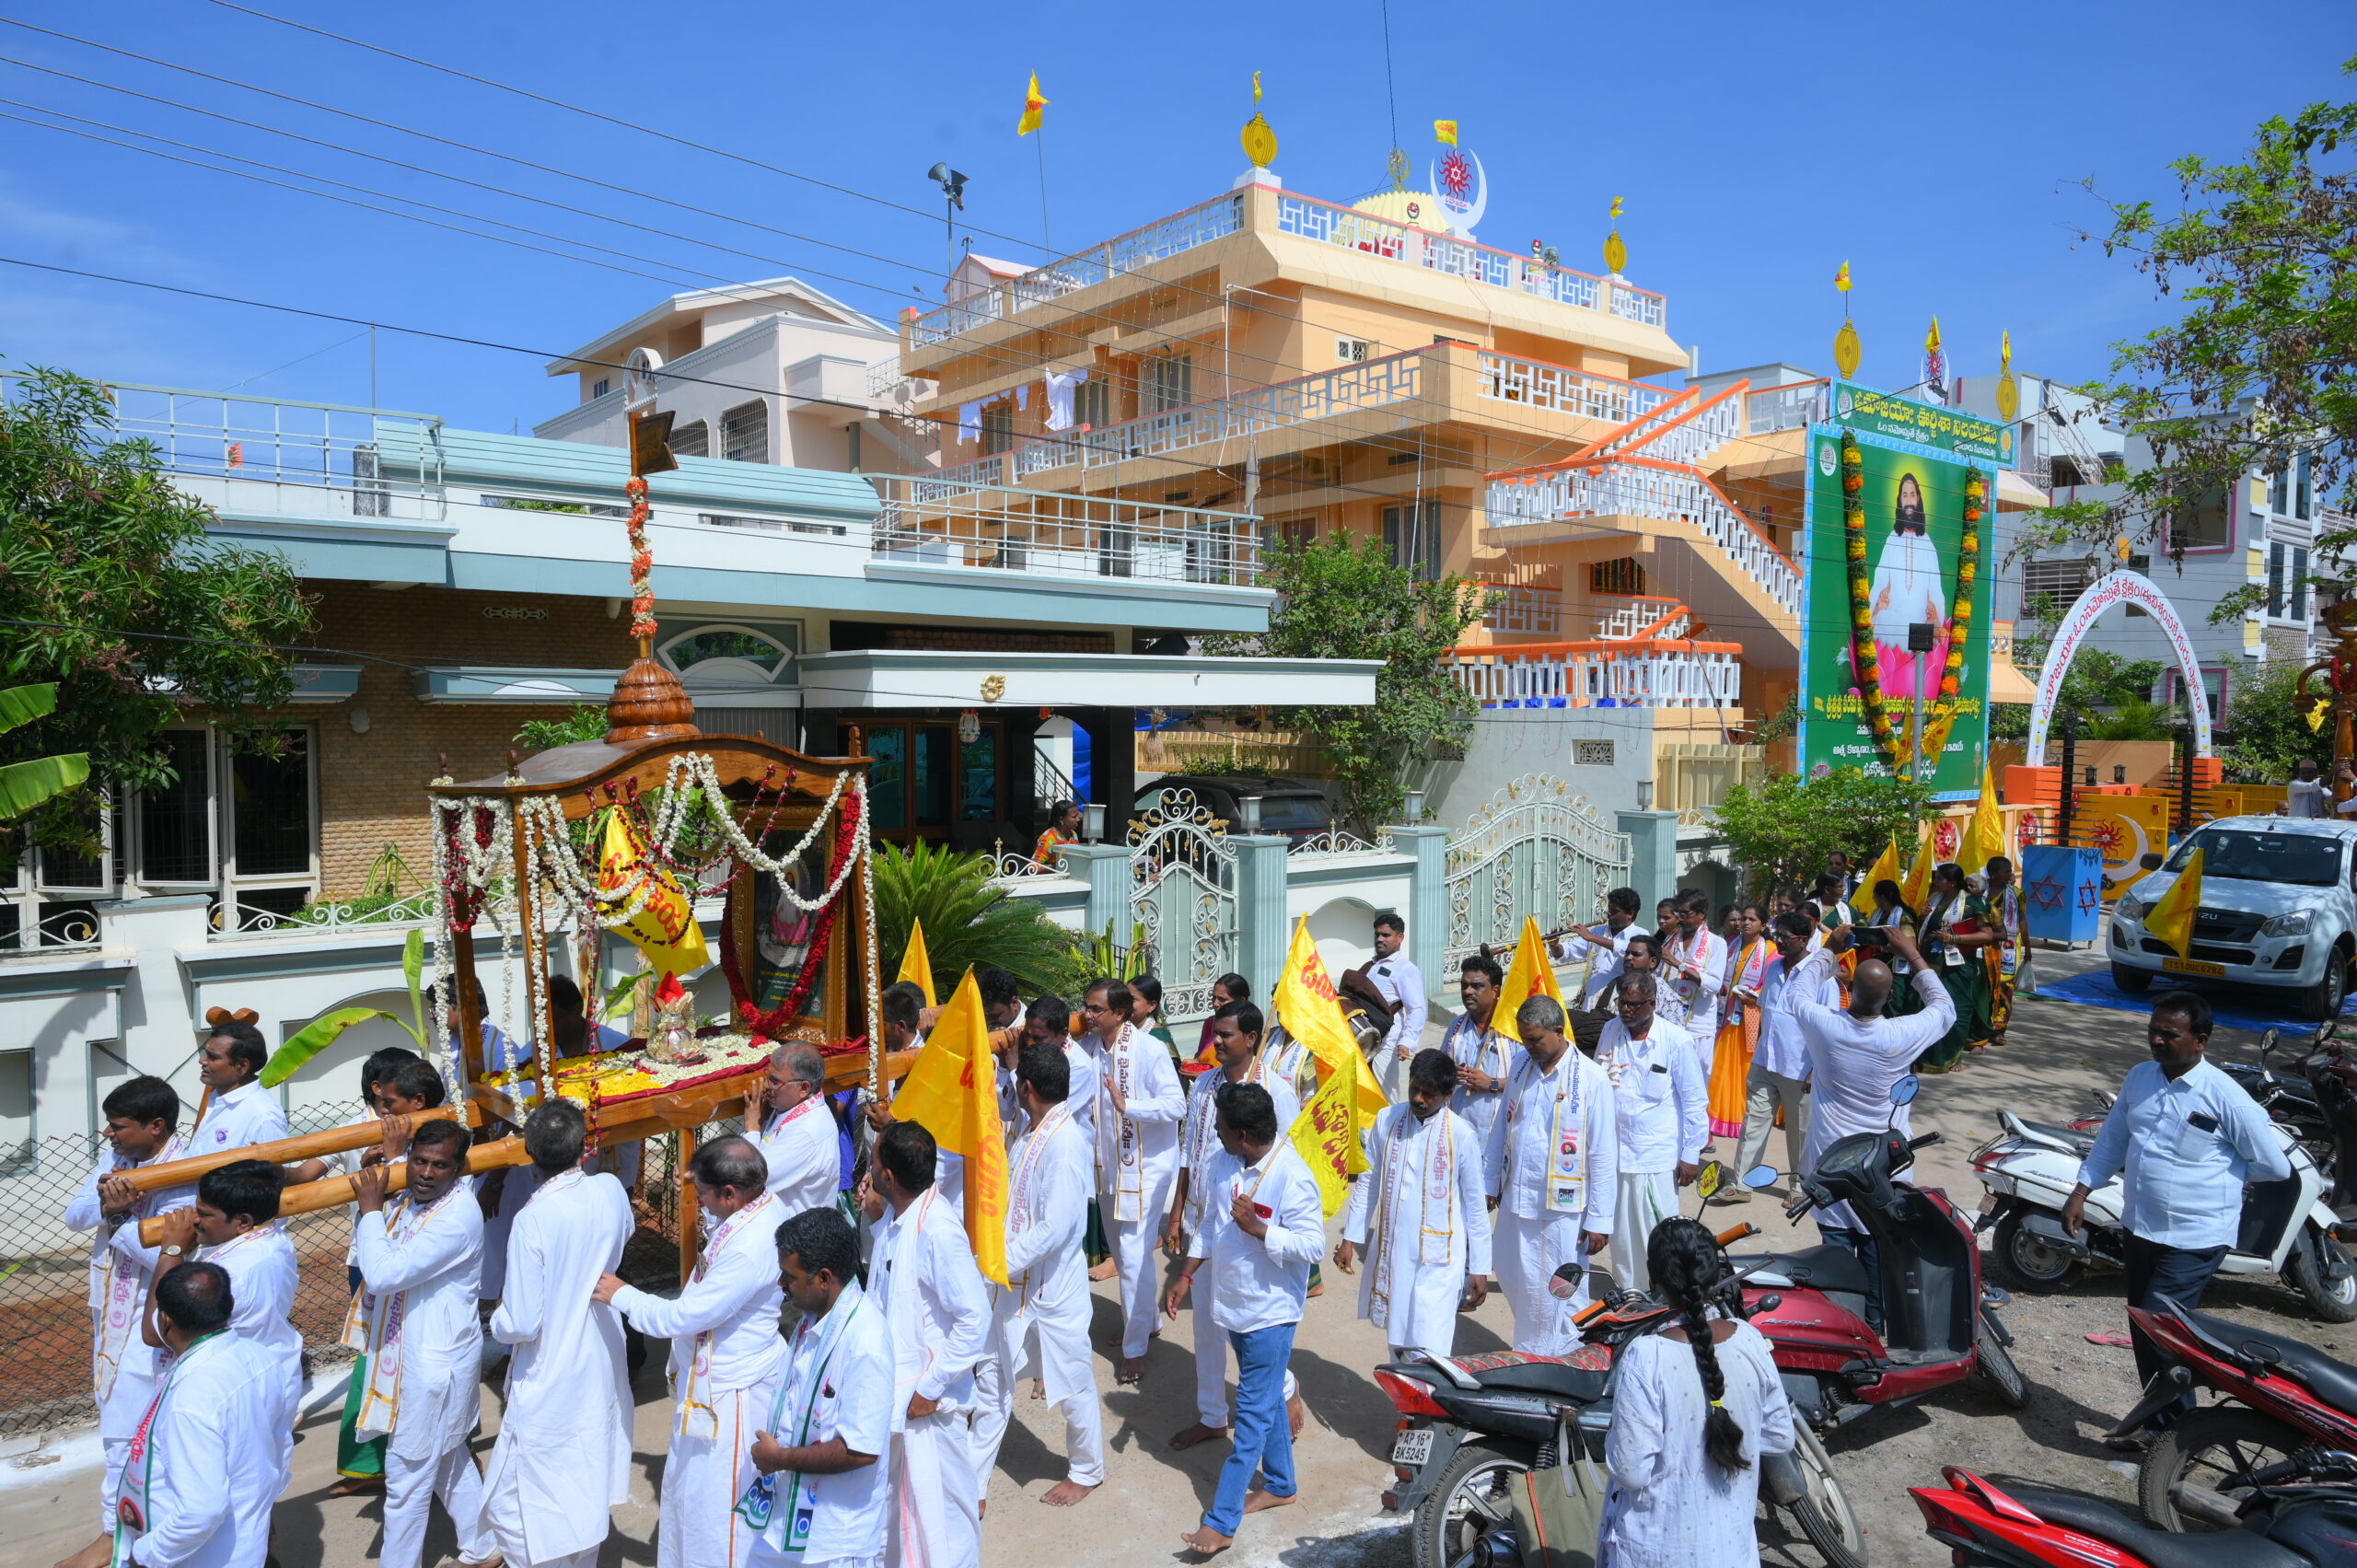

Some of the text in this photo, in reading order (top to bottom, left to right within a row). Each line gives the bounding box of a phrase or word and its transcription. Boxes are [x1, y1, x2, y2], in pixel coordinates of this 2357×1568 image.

[1403, 1432, 1425, 1446] AP 16
[1395, 1446, 1425, 1461] BK5245
